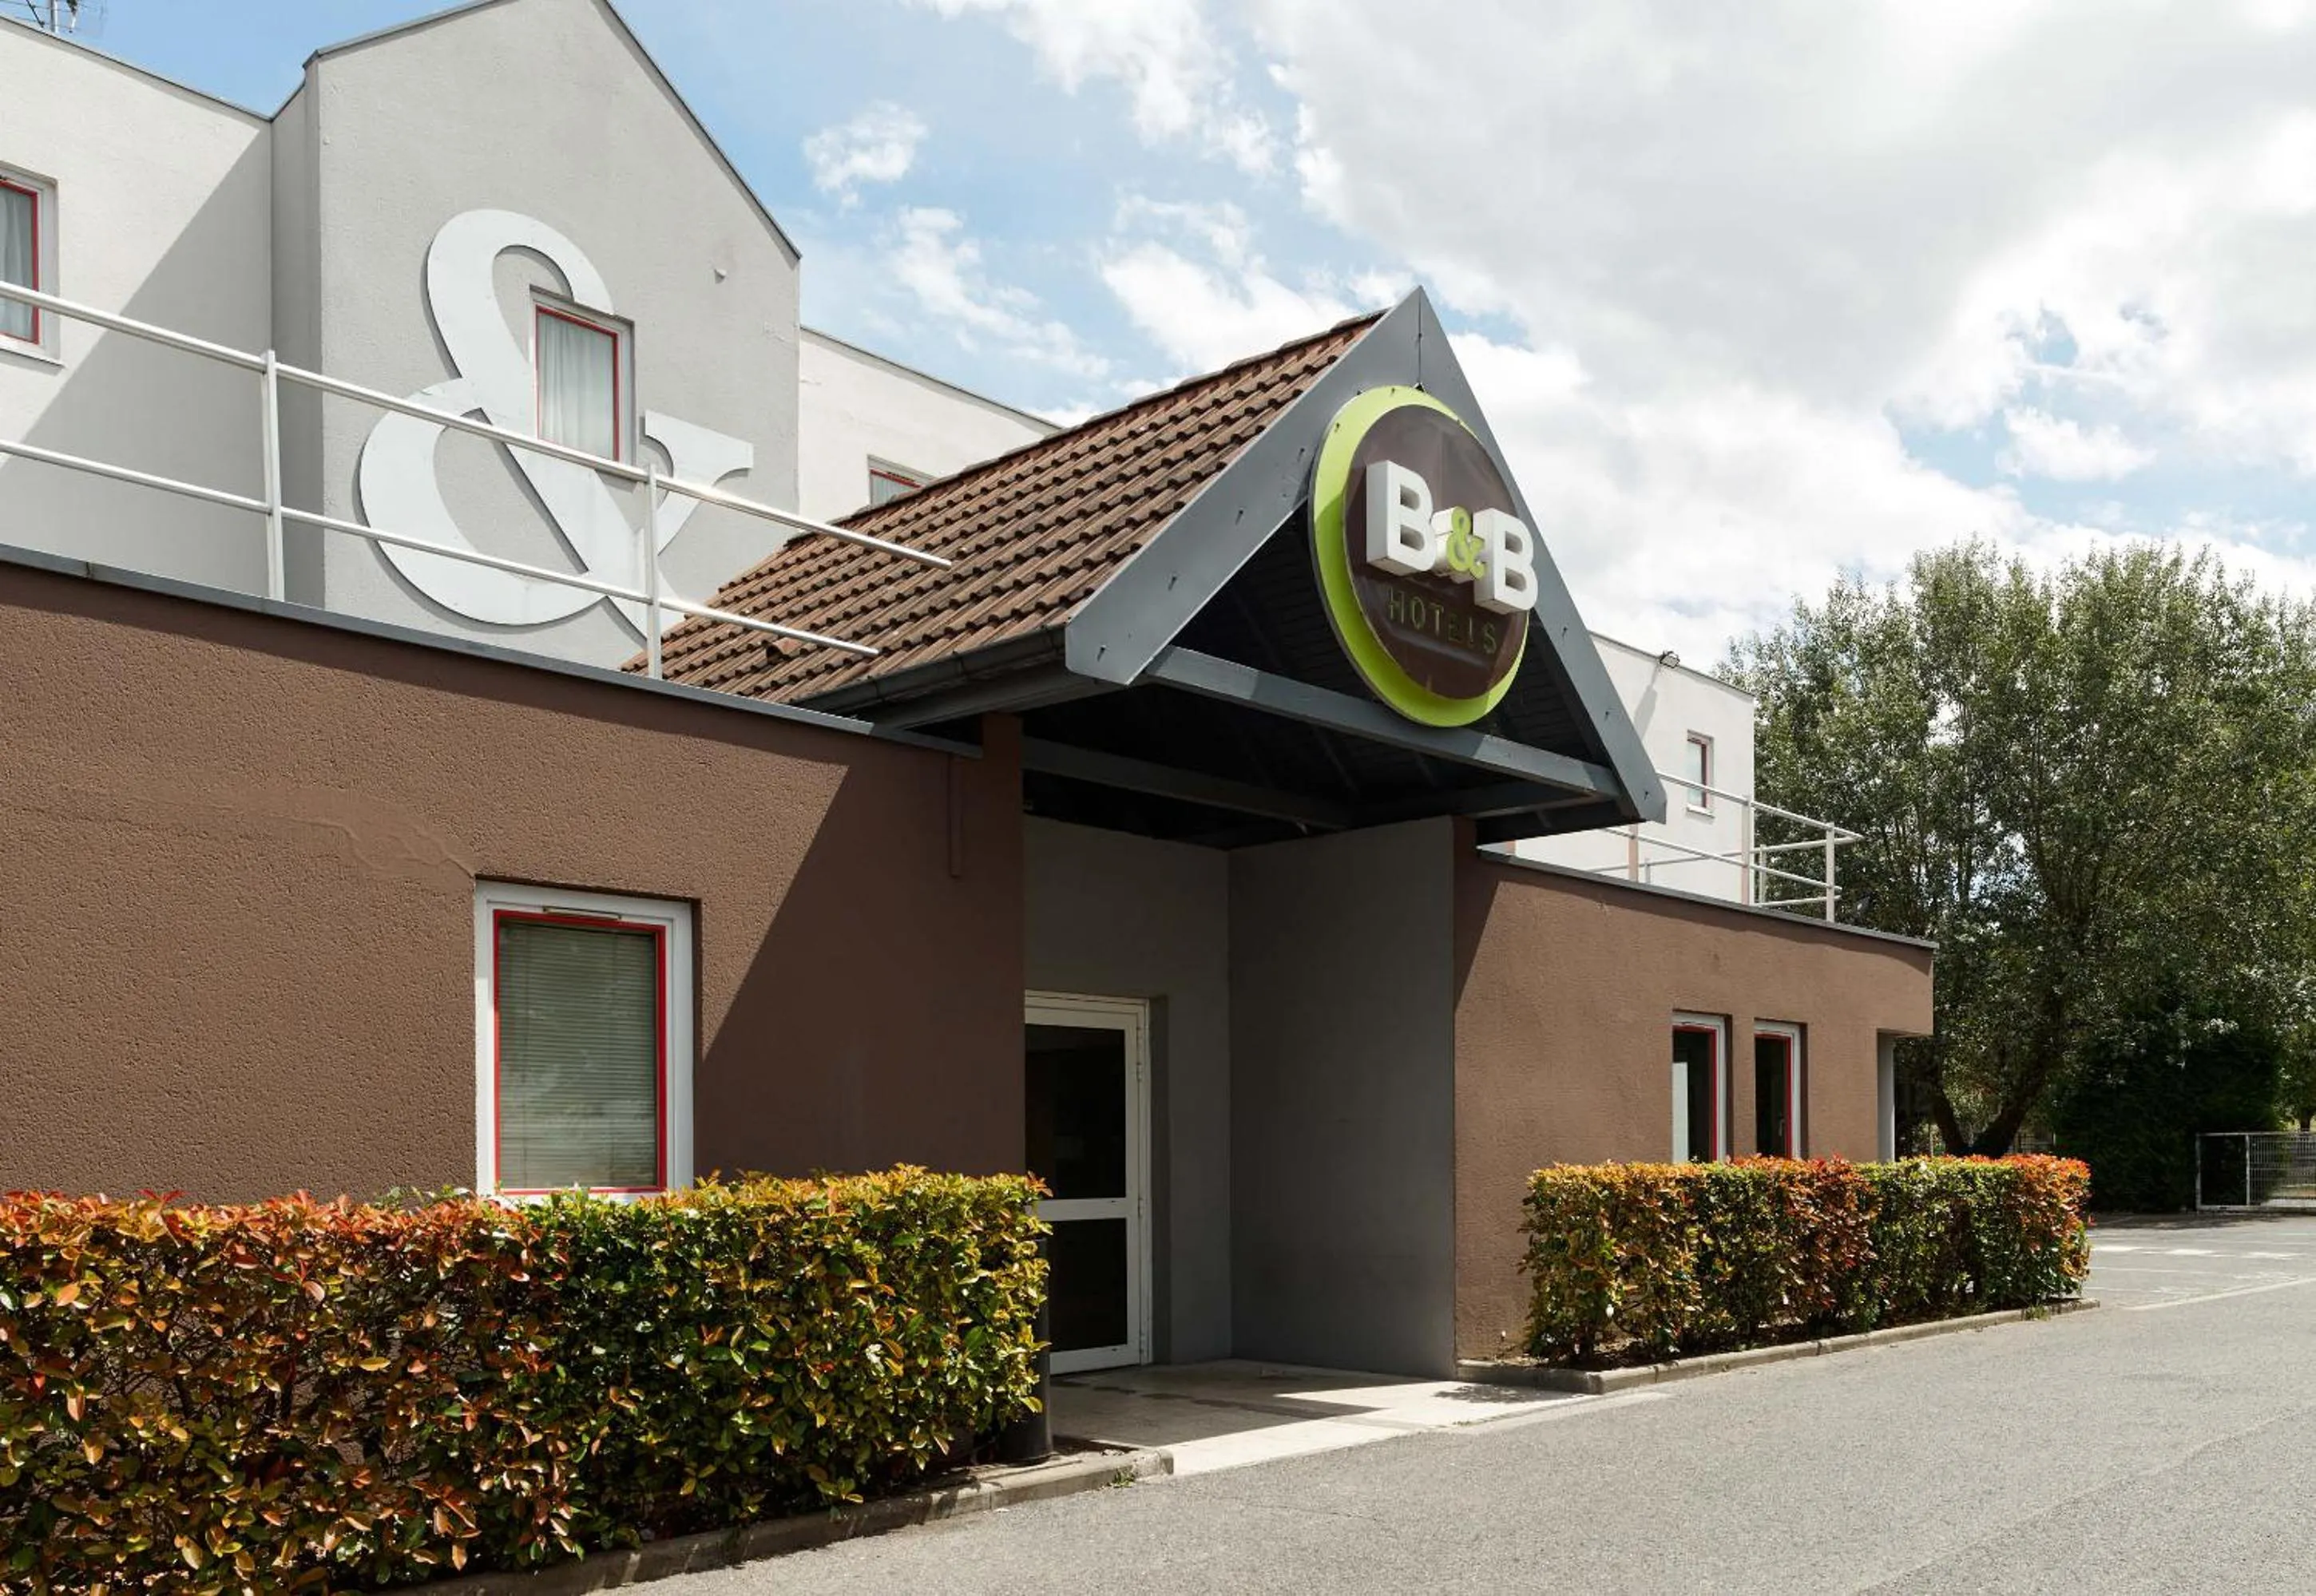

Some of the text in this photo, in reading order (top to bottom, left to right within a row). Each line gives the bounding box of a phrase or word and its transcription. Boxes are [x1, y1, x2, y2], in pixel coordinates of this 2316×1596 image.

[359, 208, 753, 644] &
[1366, 460, 1538, 615] B&B
[1387, 587, 1497, 654] HOTELS
